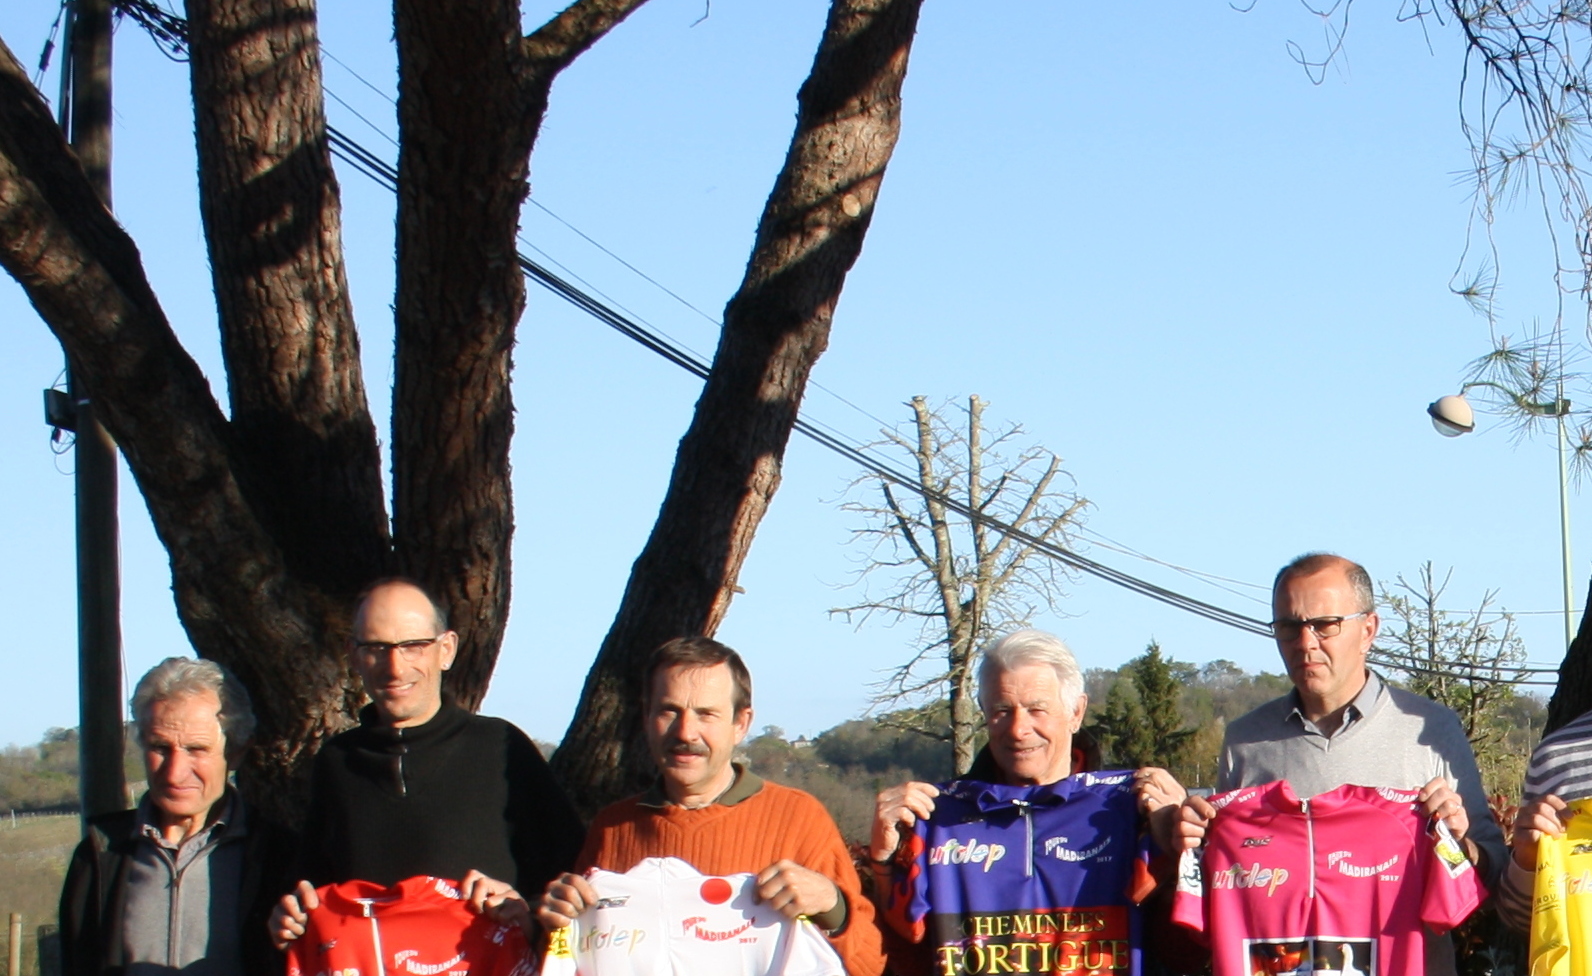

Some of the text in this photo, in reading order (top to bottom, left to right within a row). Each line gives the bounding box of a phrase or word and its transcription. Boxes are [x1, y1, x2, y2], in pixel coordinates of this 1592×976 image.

[929, 838, 1006, 874] ufolep
[1339, 854, 1399, 878] MADIRANAIS
[1212, 862, 1289, 898] ufolep
